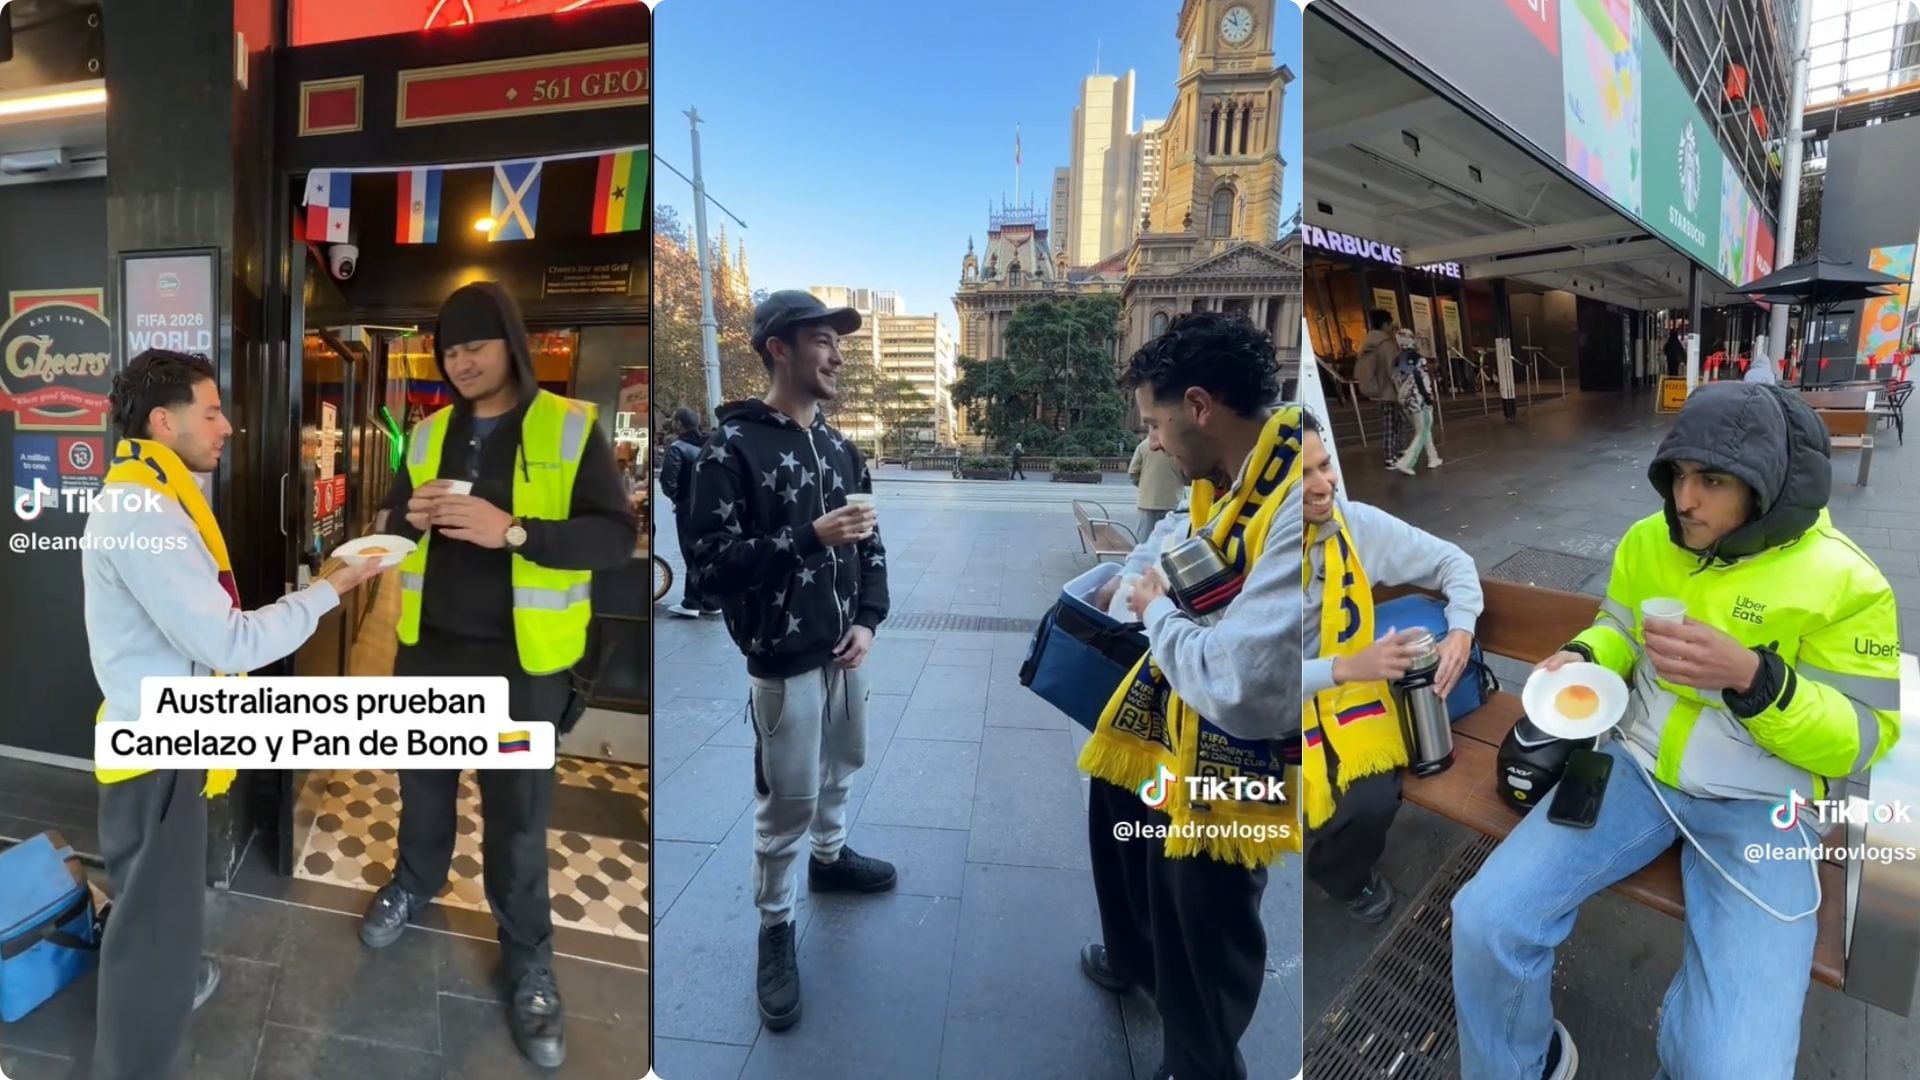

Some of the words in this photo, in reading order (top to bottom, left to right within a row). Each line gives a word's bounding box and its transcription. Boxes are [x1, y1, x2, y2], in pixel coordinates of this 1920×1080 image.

[532, 76, 572, 102] 561
[1669, 205, 1706, 248] STARBUCKS
[29, 315, 52, 327] EST
[137, 313, 167, 327] FIFA
[170, 312, 204, 327] 2026
[128, 329, 212, 352] WORLD
[5, 334, 111, 383] Cheers
[20, 453, 26, 461] A
[27, 452, 51, 462] million
[23, 462, 32, 470] to
[1735, 595, 1767, 613] Uber
[1732, 606, 1764, 625] Eats
[1200, 731, 1228, 745] FIFA
[1199, 741, 1255, 758] WOMEN'S
[1243, 757, 1267, 767] CUP
